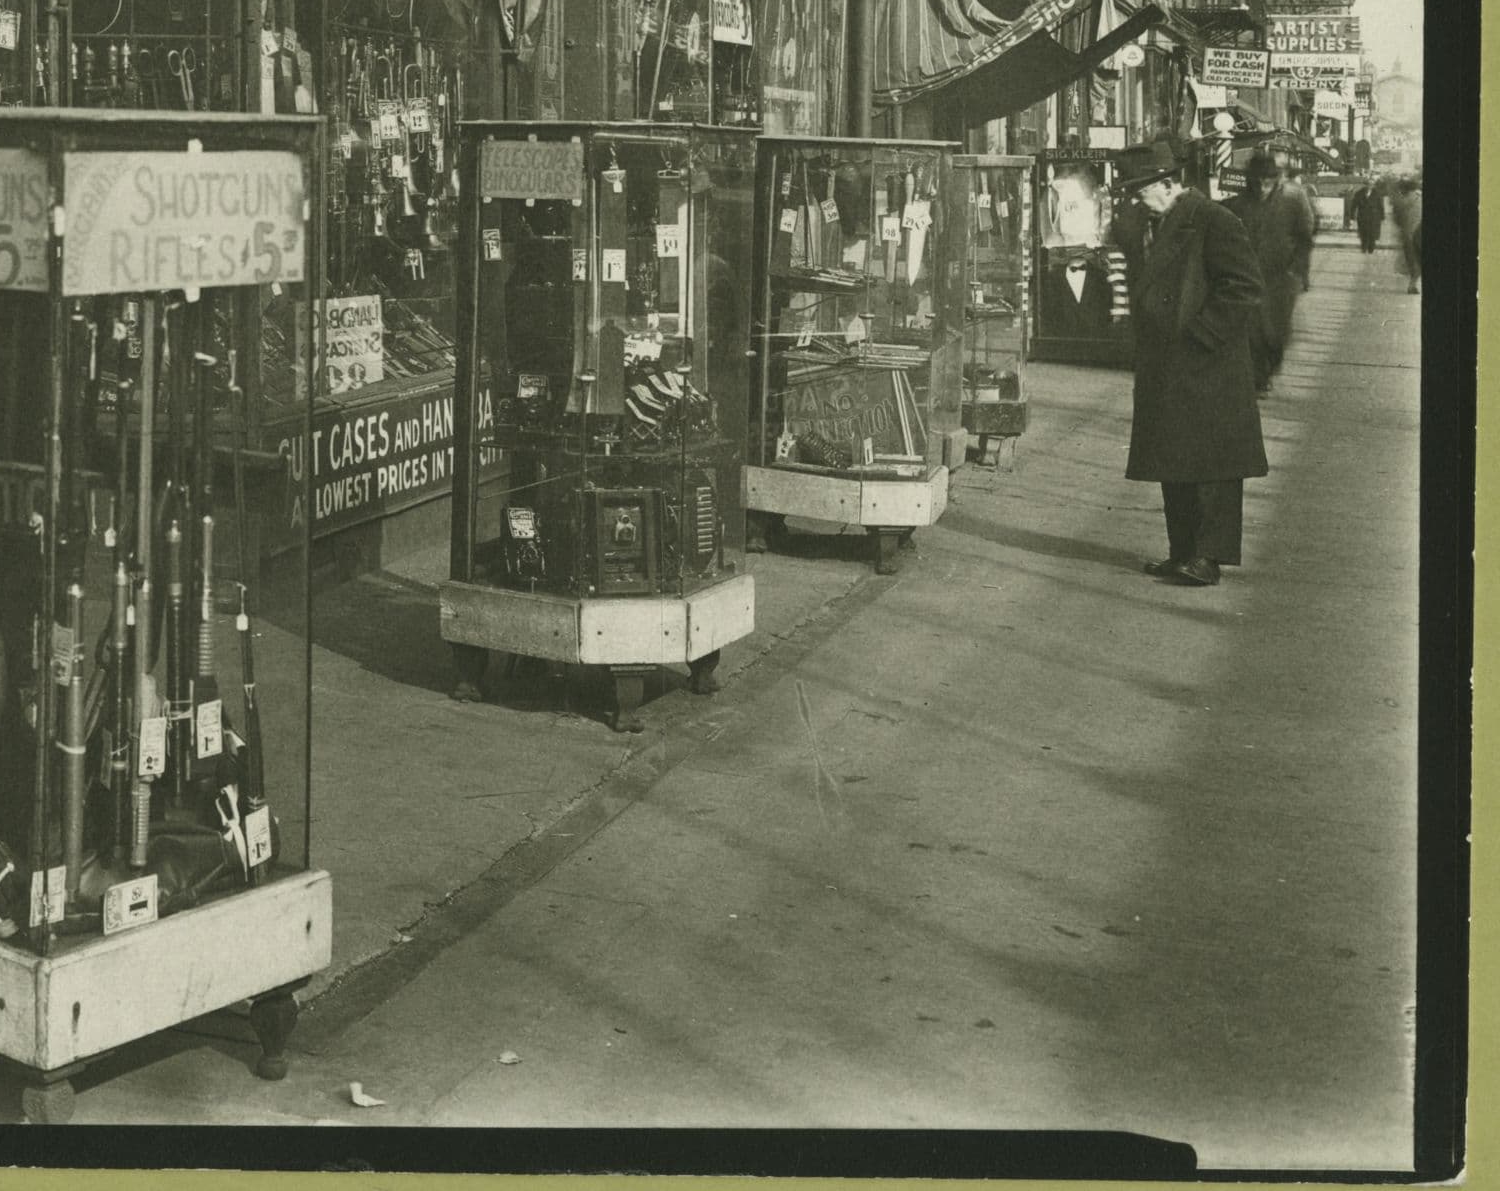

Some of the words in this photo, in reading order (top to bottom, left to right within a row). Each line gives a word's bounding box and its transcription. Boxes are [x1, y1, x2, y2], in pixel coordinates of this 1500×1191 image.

[1273, 20, 1341, 35] ARTIST
[1267, 37, 1348, 51] SUPPLIES
[1213, 50, 1231, 58] WE
[1236, 51, 1262, 60] BUY
[1208, 59, 1230, 69] FOR
[1233, 60, 1265, 70] CASH
[110, 229, 236, 286] RIFLES
[329, 411, 389, 470] CASES
[394, 419, 420, 453] AND
[423, 397, 454, 444] HAN
[316, 472, 371, 519] LOWEST
[377, 454, 427, 497] PRICES
[432, 450, 445, 482] IN
